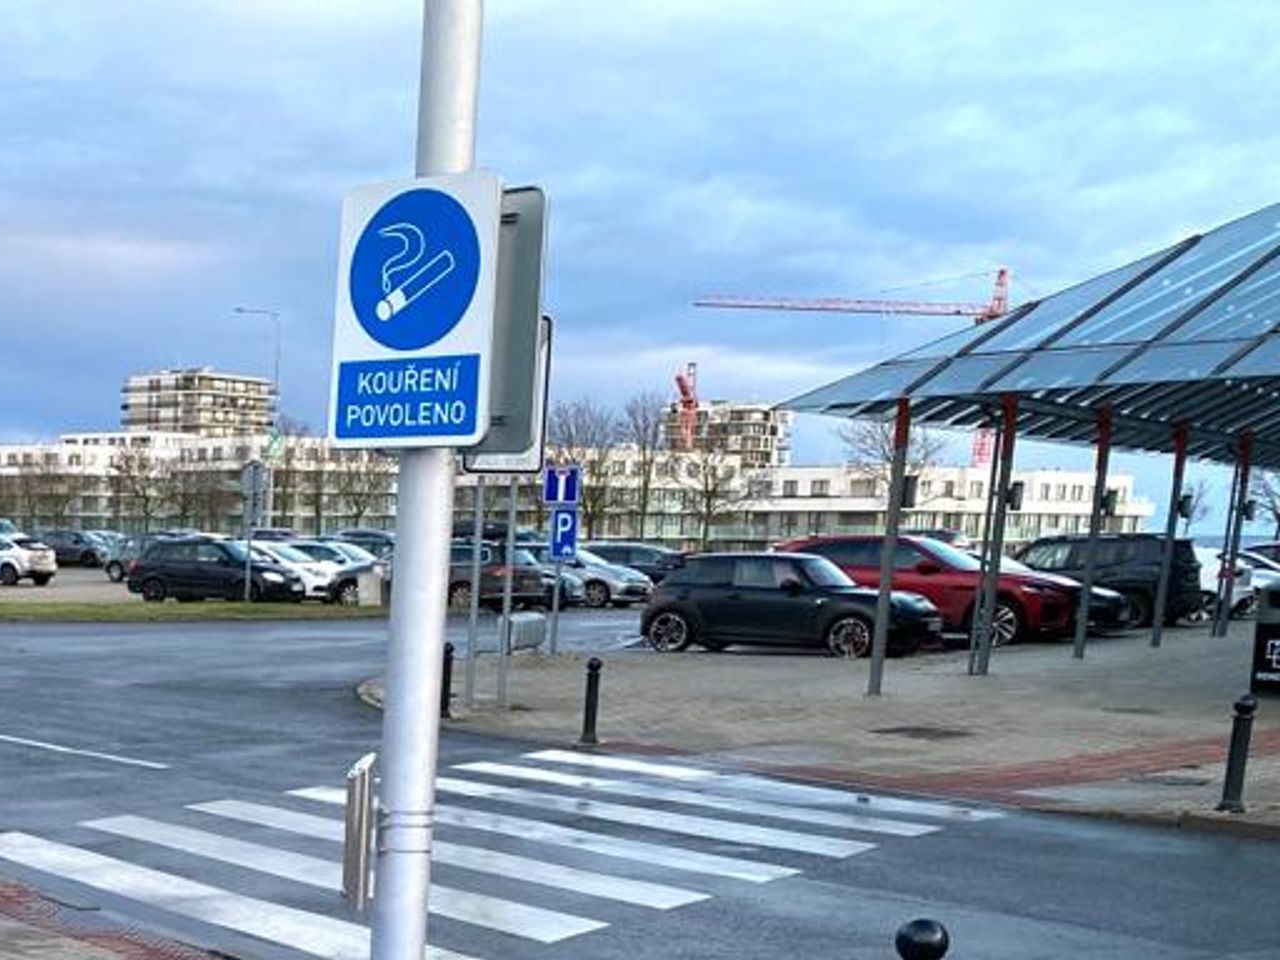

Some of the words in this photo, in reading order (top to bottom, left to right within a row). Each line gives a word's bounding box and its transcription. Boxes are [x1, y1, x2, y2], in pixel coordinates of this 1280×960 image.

[357, 360, 461, 395] KOUŘENÍ
[346, 400, 466, 428] POVOLENO
[557, 512, 572, 543] P
